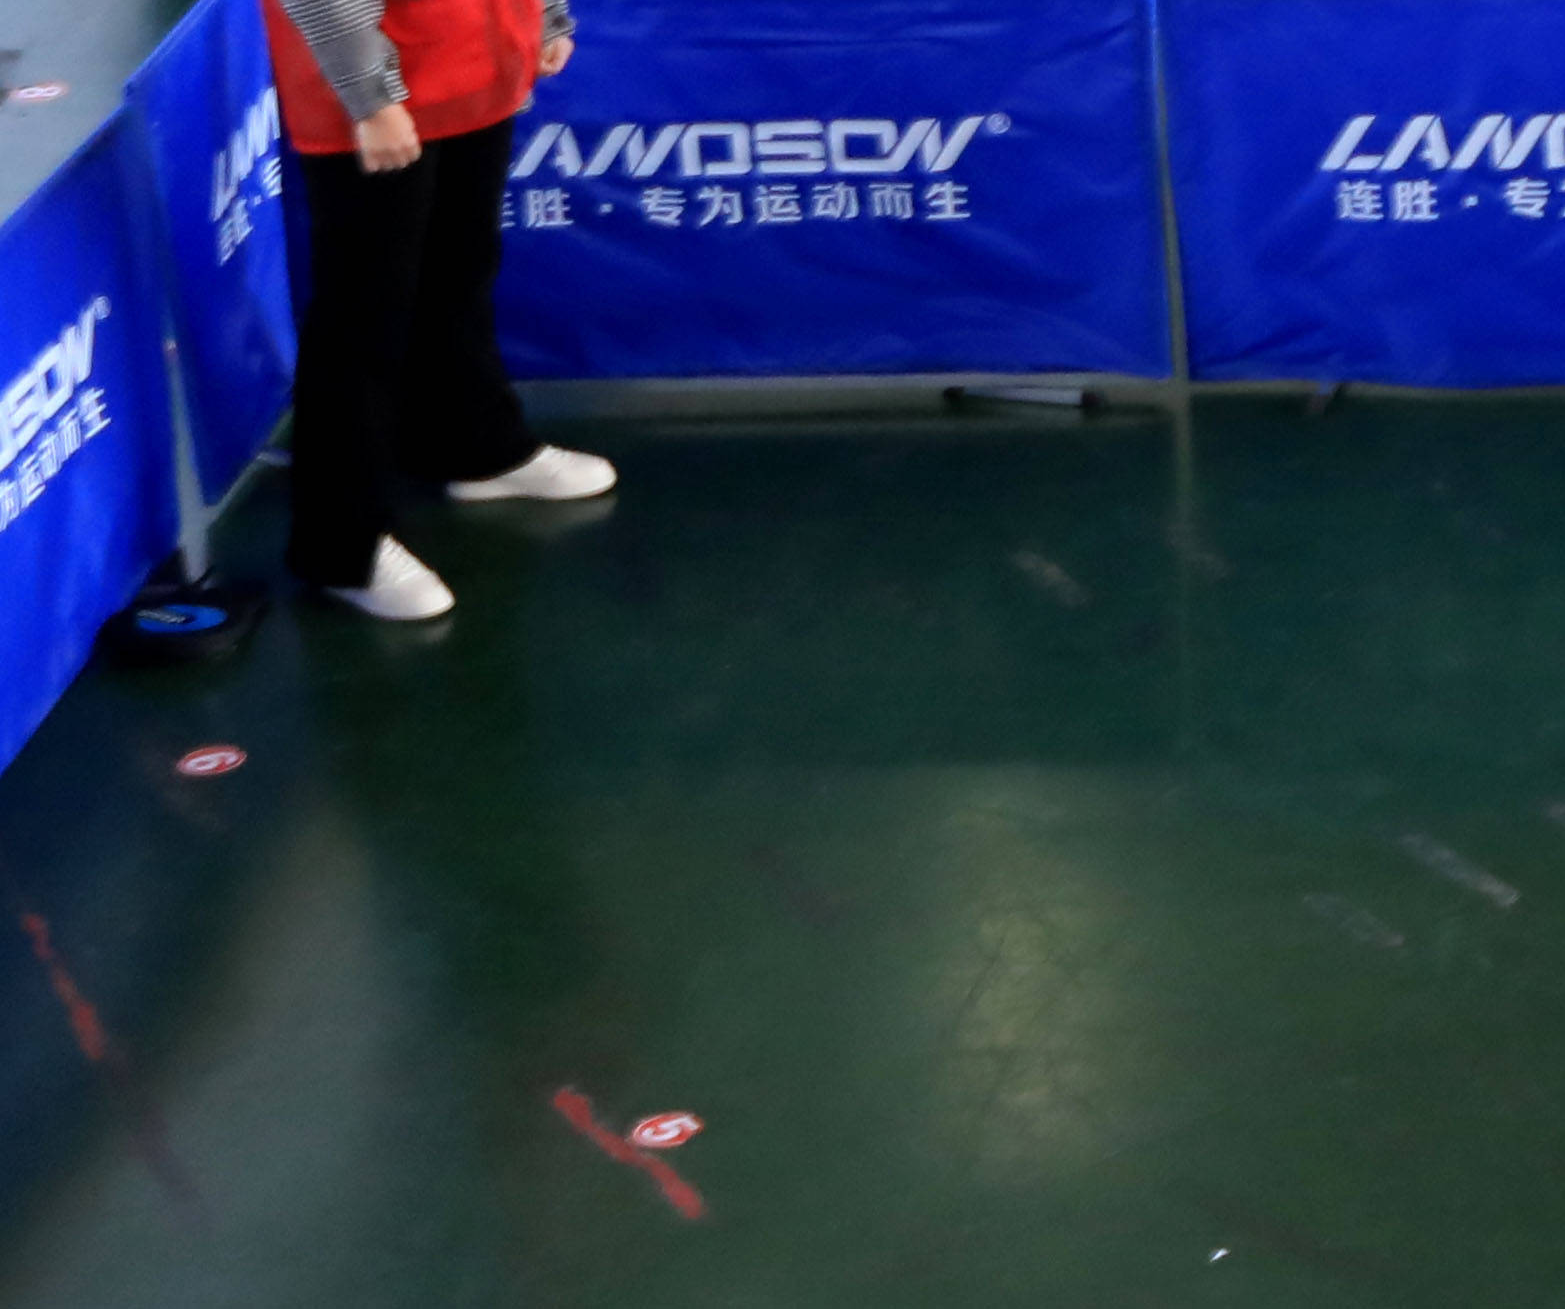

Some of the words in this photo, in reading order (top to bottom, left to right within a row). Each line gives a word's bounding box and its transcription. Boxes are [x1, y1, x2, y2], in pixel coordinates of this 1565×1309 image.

[511, 113, 985, 177] ANDSON
[524, 180, 972, 228] 胜·专为运动而生
